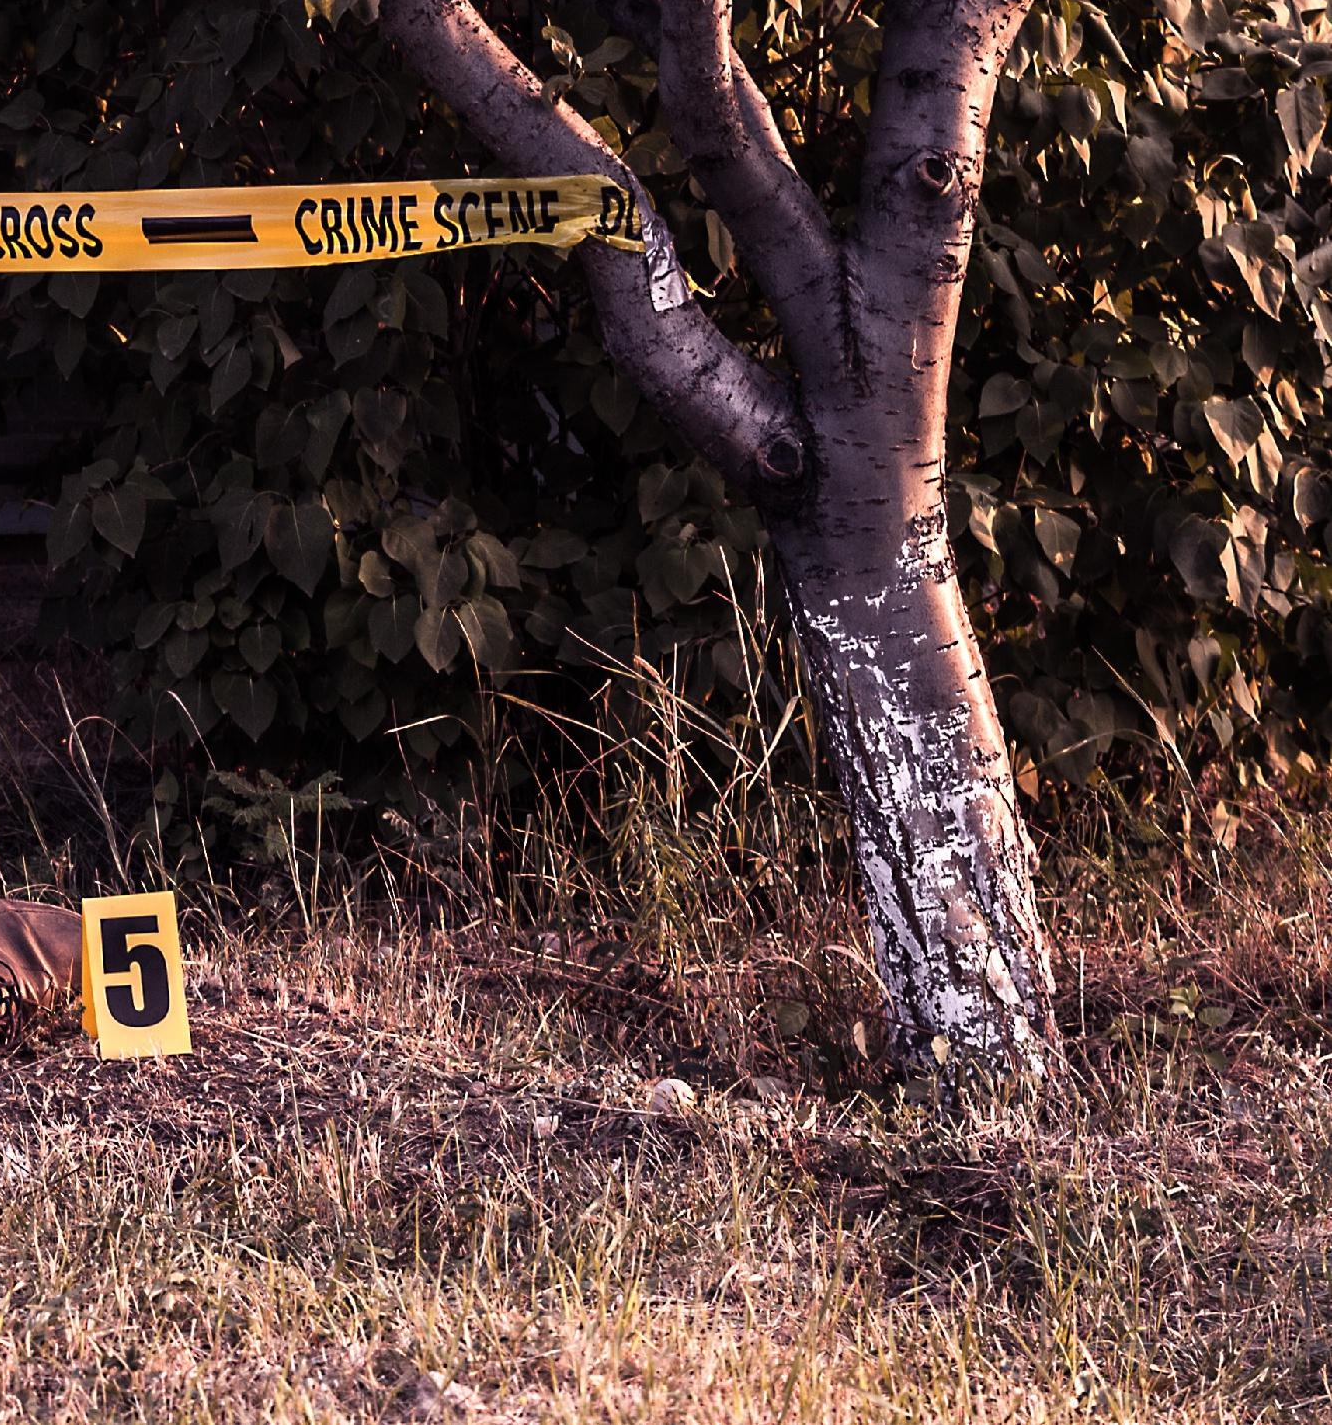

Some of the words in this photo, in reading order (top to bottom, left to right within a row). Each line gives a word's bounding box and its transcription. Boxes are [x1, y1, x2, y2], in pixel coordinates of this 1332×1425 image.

[294, 195, 424, 255] CRIME
[434, 189, 560, 248] SCENE
[99, 914, 170, 1028] 5
